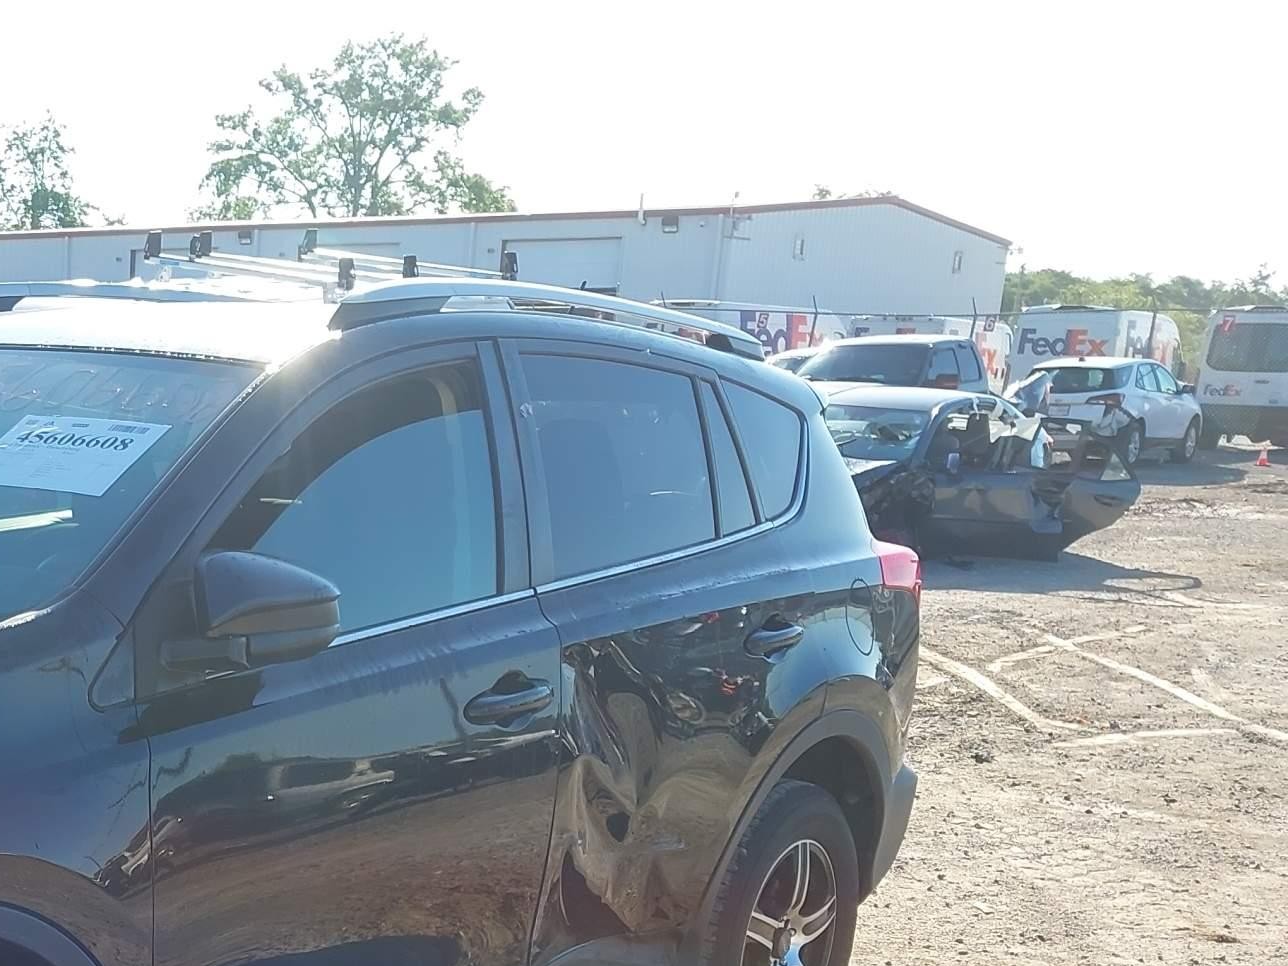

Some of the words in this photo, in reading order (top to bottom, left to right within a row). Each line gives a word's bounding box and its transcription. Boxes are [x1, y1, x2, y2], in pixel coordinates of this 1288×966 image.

[1224, 316, 1234, 331] 7
[1017, 328, 1109, 356] FedEx
[16, 430, 135, 451] 45606608
